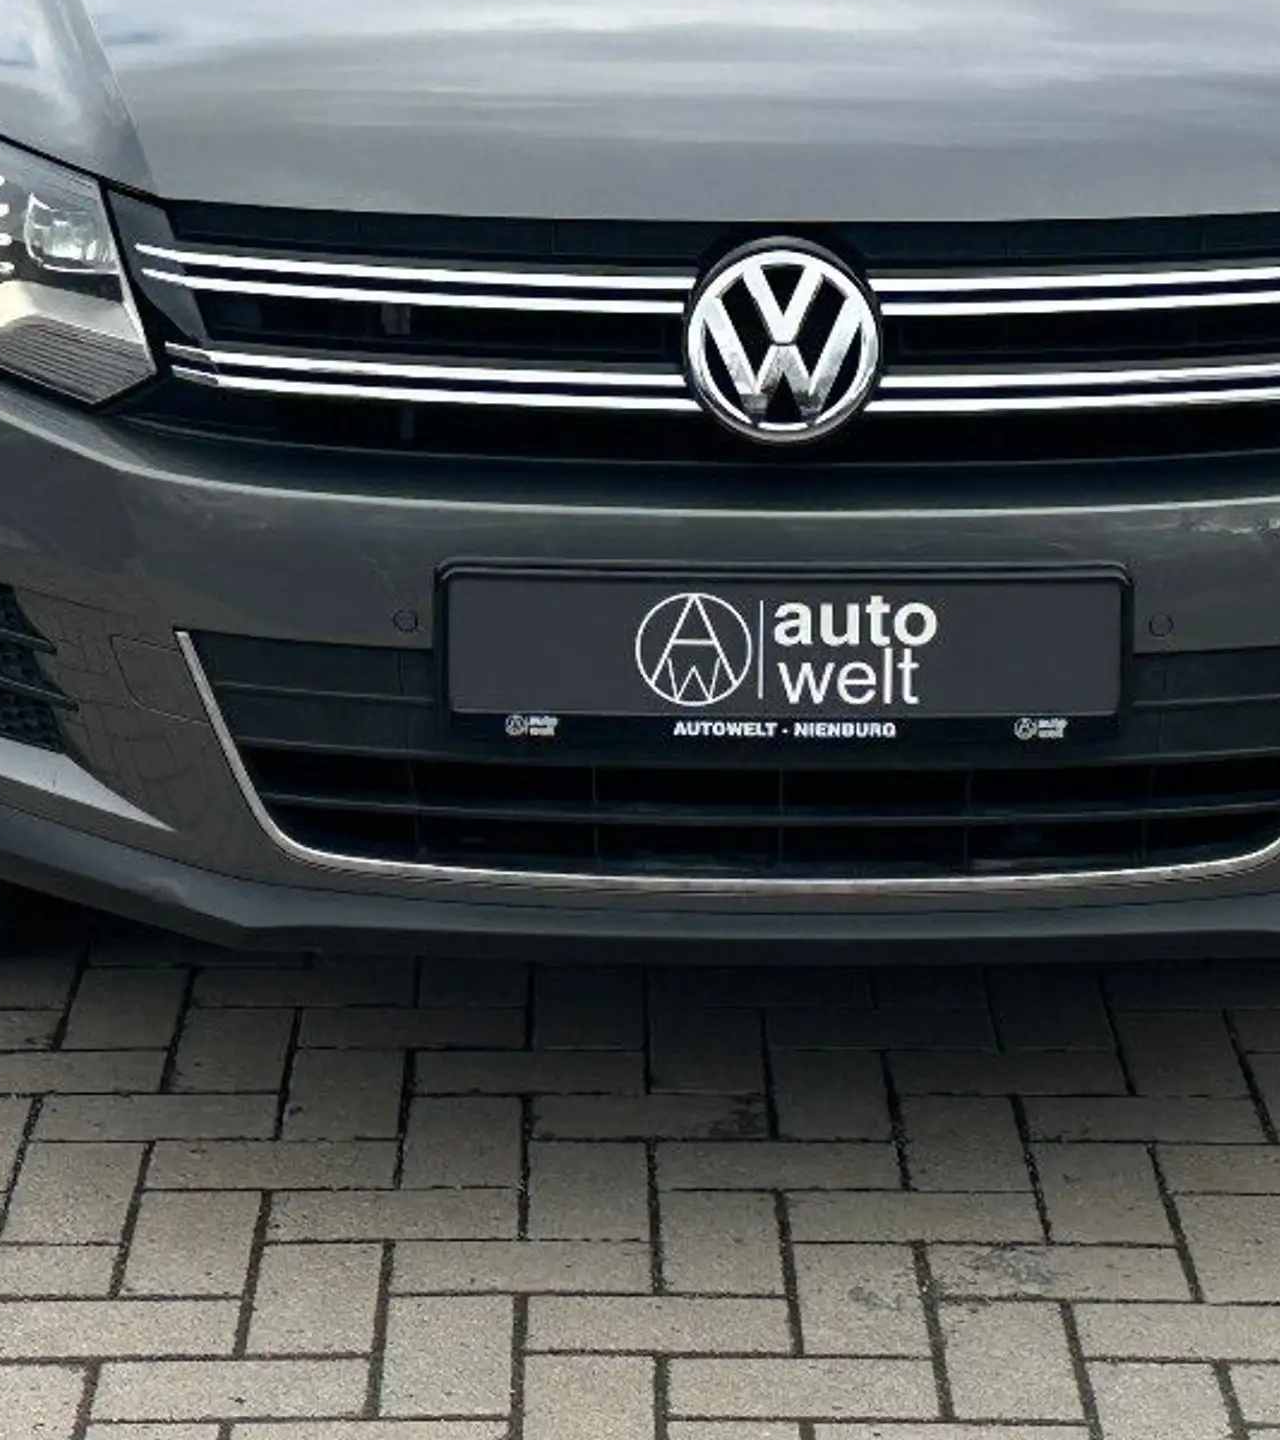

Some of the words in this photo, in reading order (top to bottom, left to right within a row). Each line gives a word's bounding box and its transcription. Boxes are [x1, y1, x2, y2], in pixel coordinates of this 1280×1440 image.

[773, 595, 937, 647] auto
[776, 647, 919, 705] welt
[672, 720, 778, 737] AUTOWELT
[793, 721, 897, 738] NIENBURG
